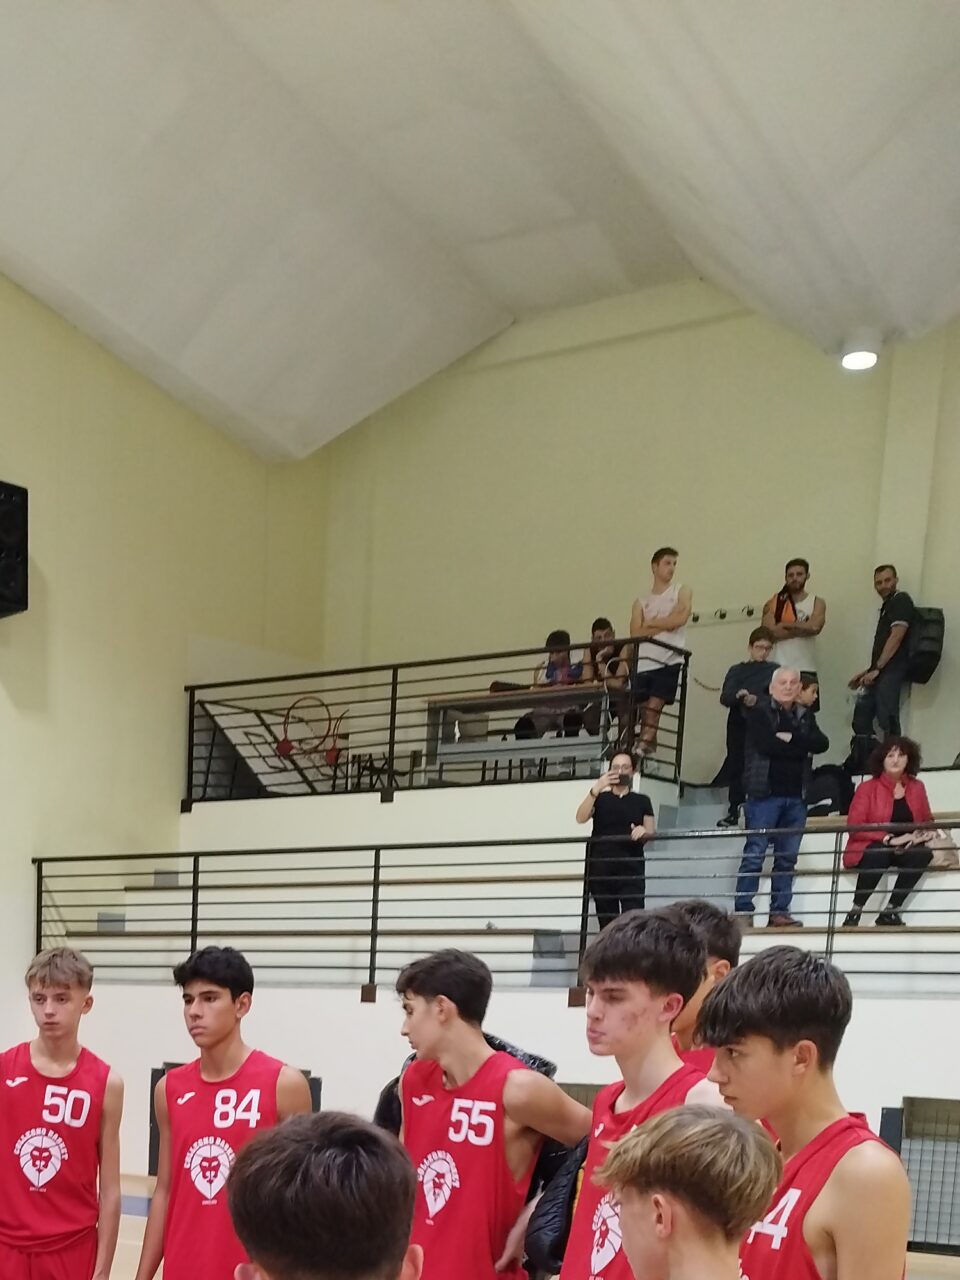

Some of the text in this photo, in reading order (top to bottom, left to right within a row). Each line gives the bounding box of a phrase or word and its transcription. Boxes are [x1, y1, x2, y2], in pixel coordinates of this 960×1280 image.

[42, 1085, 91, 1127] 50
[213, 1088, 261, 1128] 84
[448, 1098, 497, 1146] 55
